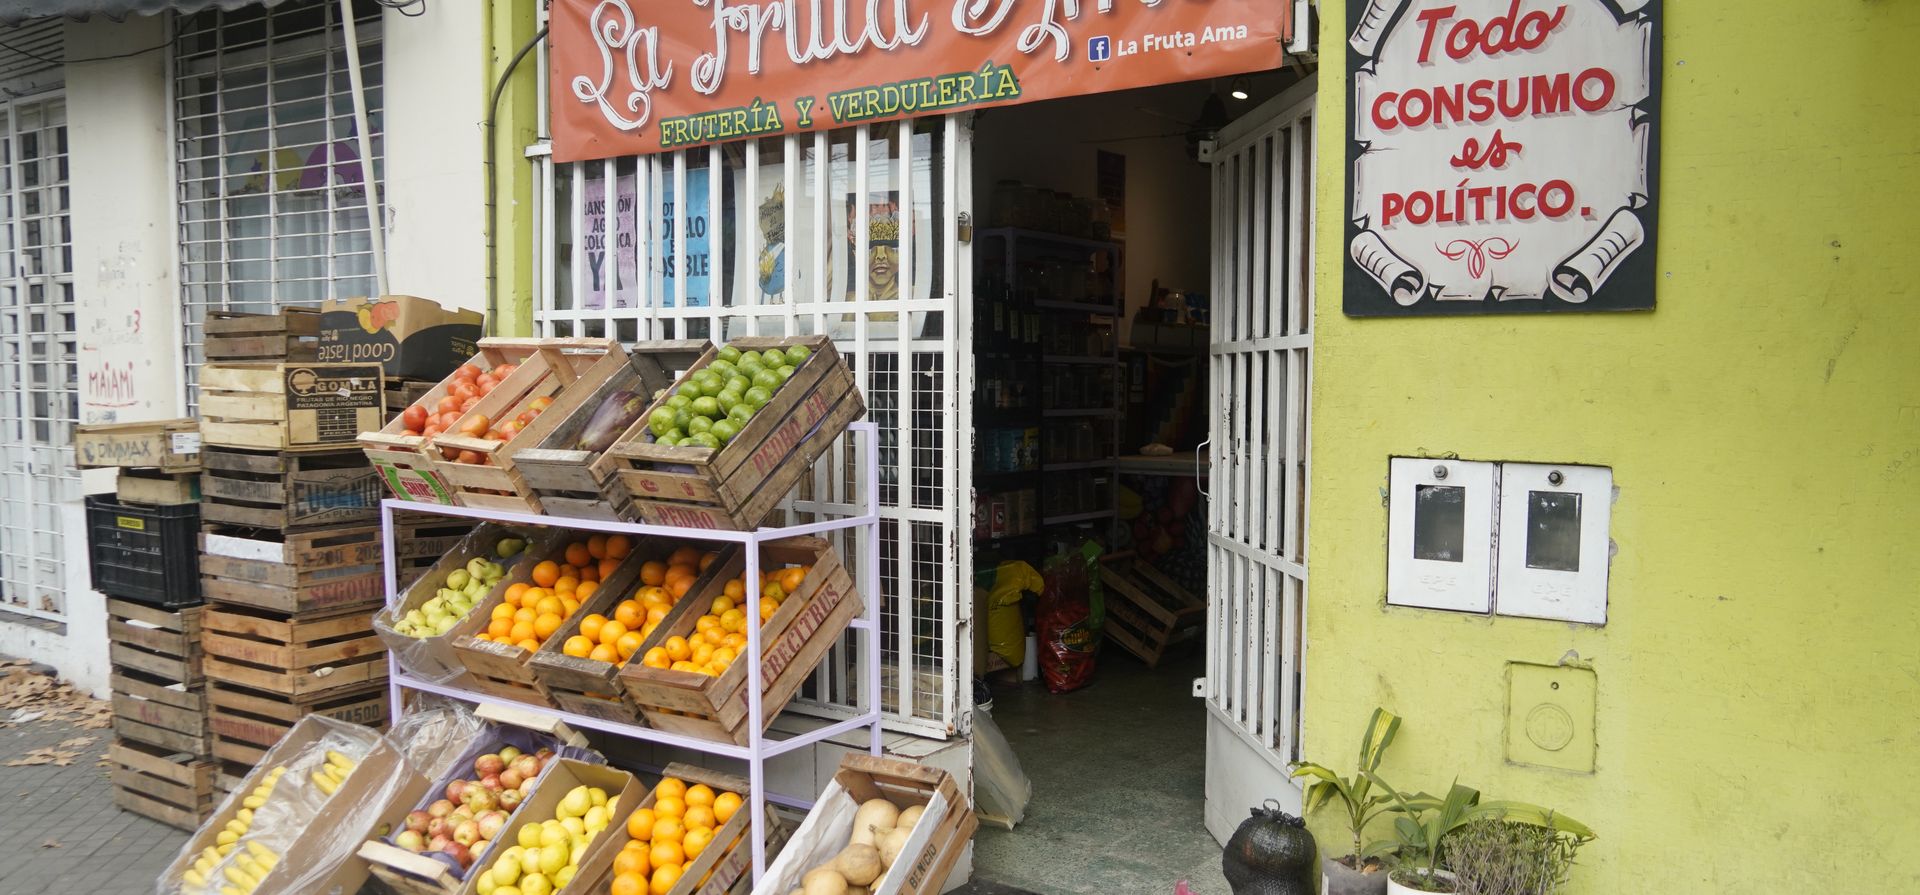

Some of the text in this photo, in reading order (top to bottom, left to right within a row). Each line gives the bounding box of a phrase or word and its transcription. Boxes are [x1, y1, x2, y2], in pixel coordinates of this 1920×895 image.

[1117, 38, 1138, 56] La
[1143, 30, 1198, 53] Fruta
[1199, 24, 1248, 45] Ama
[1416, 0, 1567, 63] Todo
[572, 0, 673, 131] La
[660, 63, 1020, 146] FRUTERÍA Y VERDULERÍA
[1371, 67, 1616, 131] CONSUMO
[1449, 128, 1523, 170] es
[1381, 177, 1592, 226] POLÍTICO.
[655, 504, 717, 530] PEDRO
[908, 842, 938, 891] BENICIO
